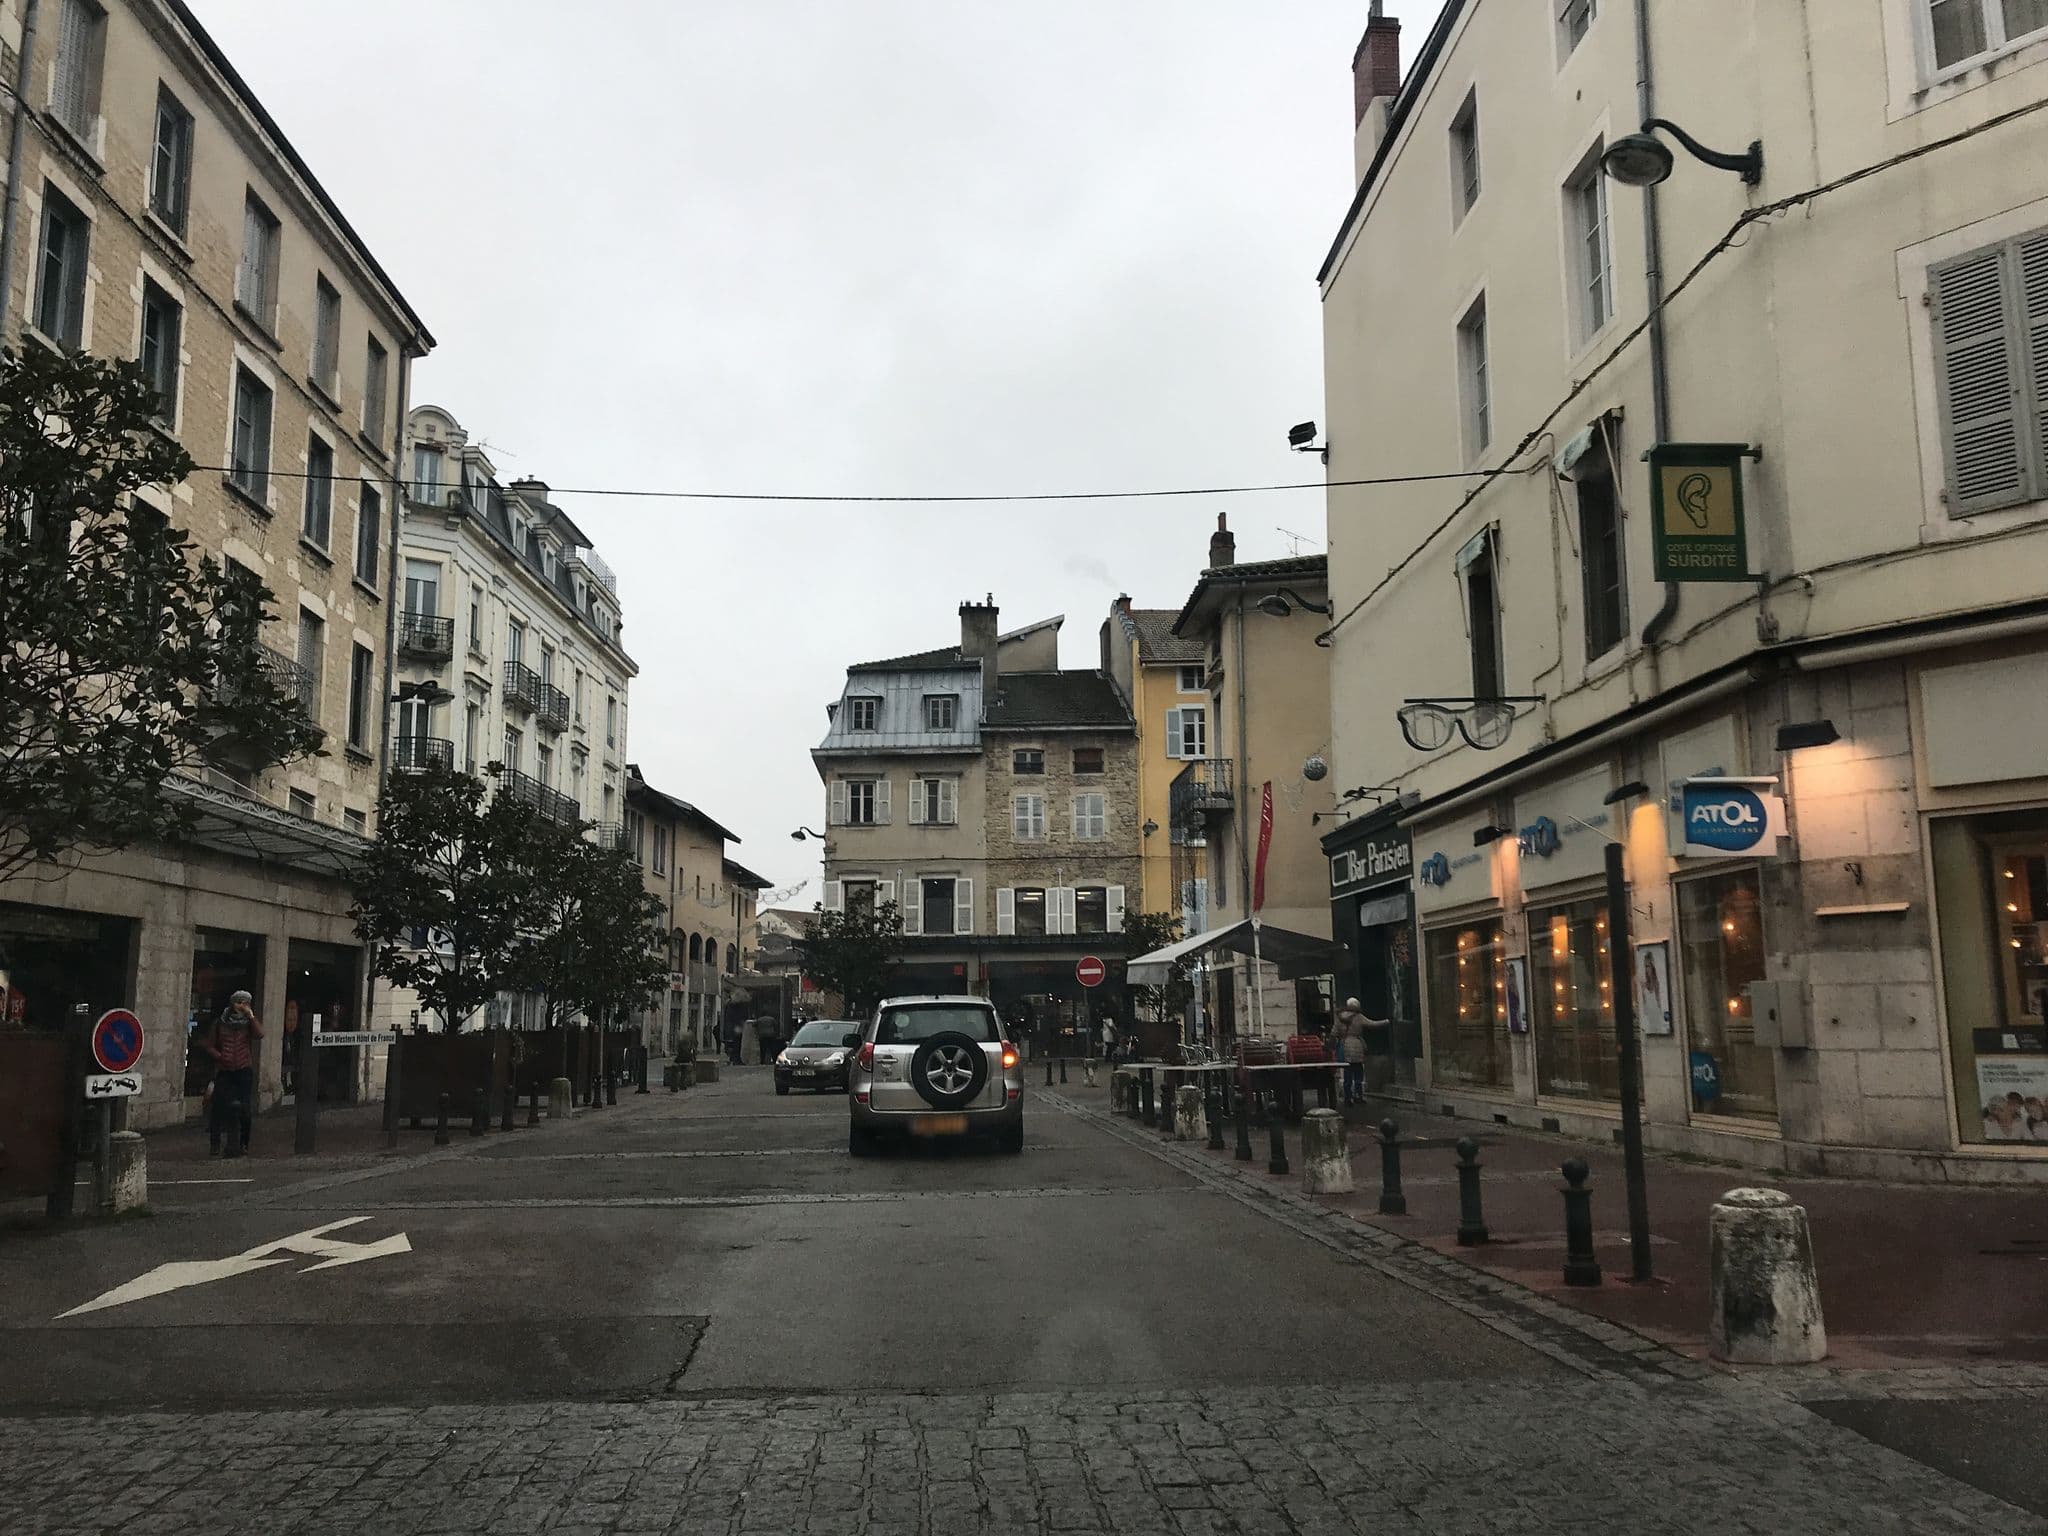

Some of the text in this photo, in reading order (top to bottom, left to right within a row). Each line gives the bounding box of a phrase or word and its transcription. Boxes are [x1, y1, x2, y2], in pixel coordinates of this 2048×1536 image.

[1691, 800, 1760, 826] ATOL
[1349, 840, 1410, 882] Bar Parisien
[322, 1034, 334, 1044] Best
[334, 1034, 355, 1044] Western
[370, 1033, 377, 1042] de
[377, 1032, 395, 1043] France
